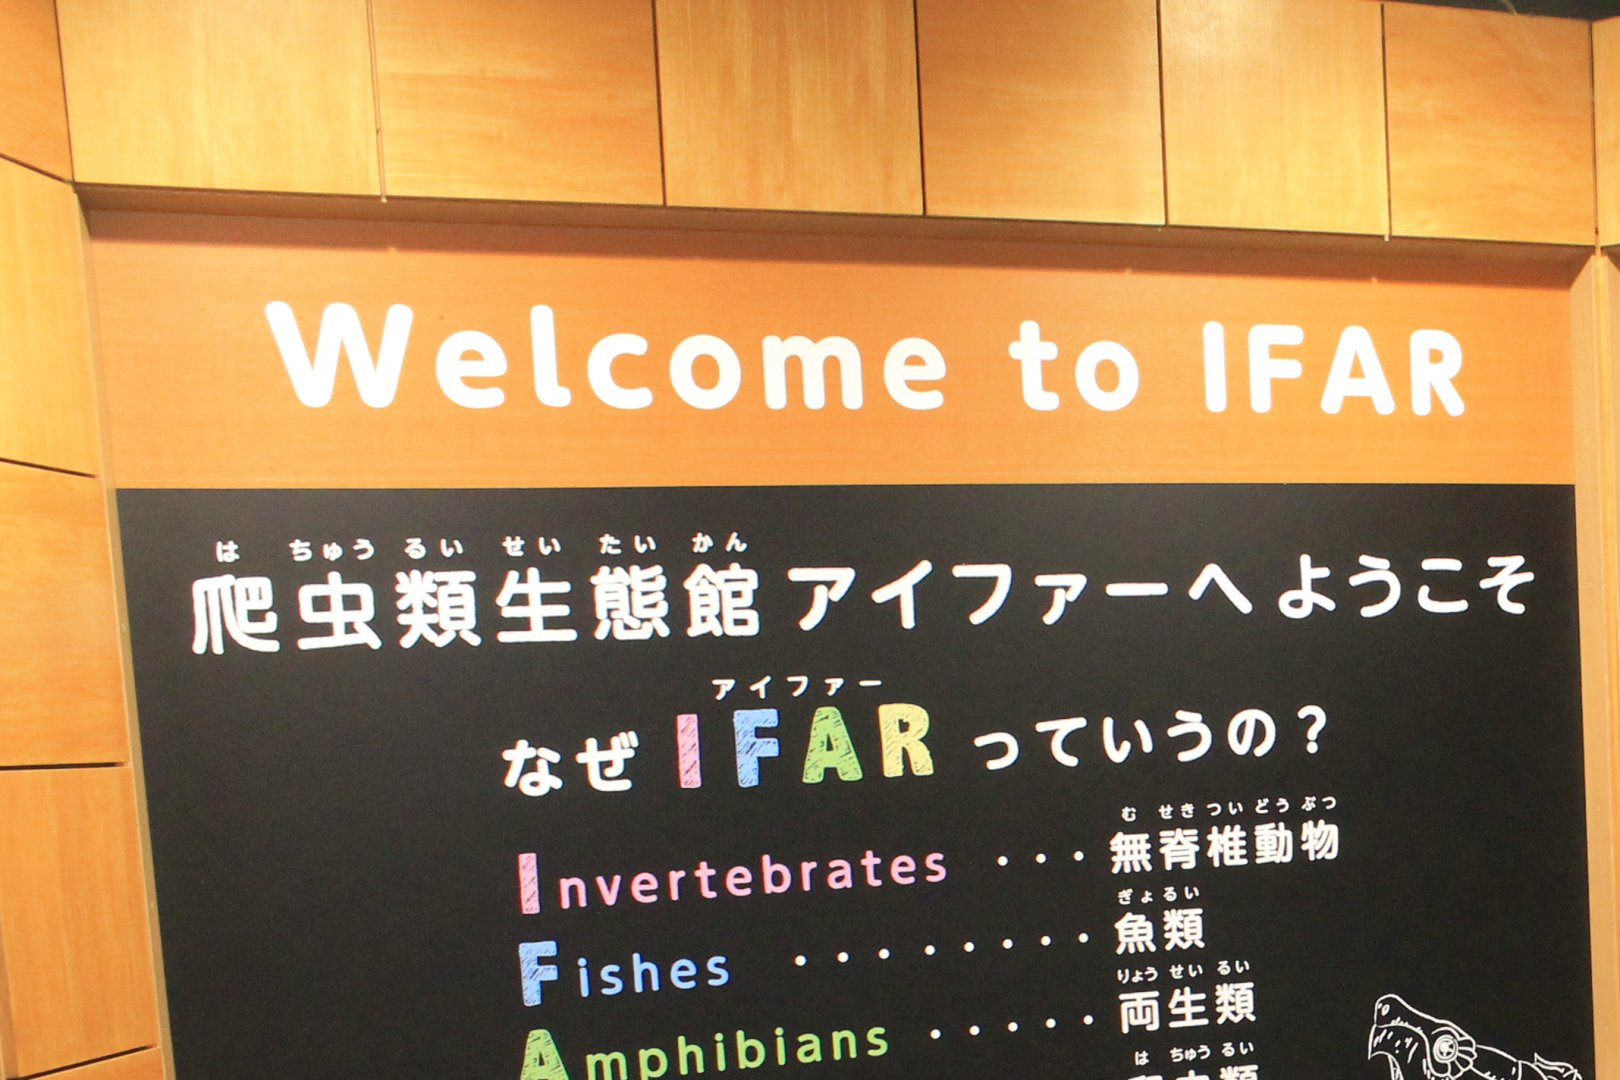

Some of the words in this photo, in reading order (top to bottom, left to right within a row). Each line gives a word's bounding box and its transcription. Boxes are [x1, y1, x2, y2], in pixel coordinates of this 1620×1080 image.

[265, 300, 947, 410] Welcome
[1009, 320, 1139, 411] to
[1203, 321, 1465, 416] IFAR
[712, 676, 883, 701] アイファー
[1109, 819, 1341, 875] 無脊椎動物
[518, 850, 948, 915] Invertebrates
[1114, 908, 1205, 955] 魚類
[518, 940, 731, 1007] Fishes
[1118, 981, 1257, 1035] 両生類
